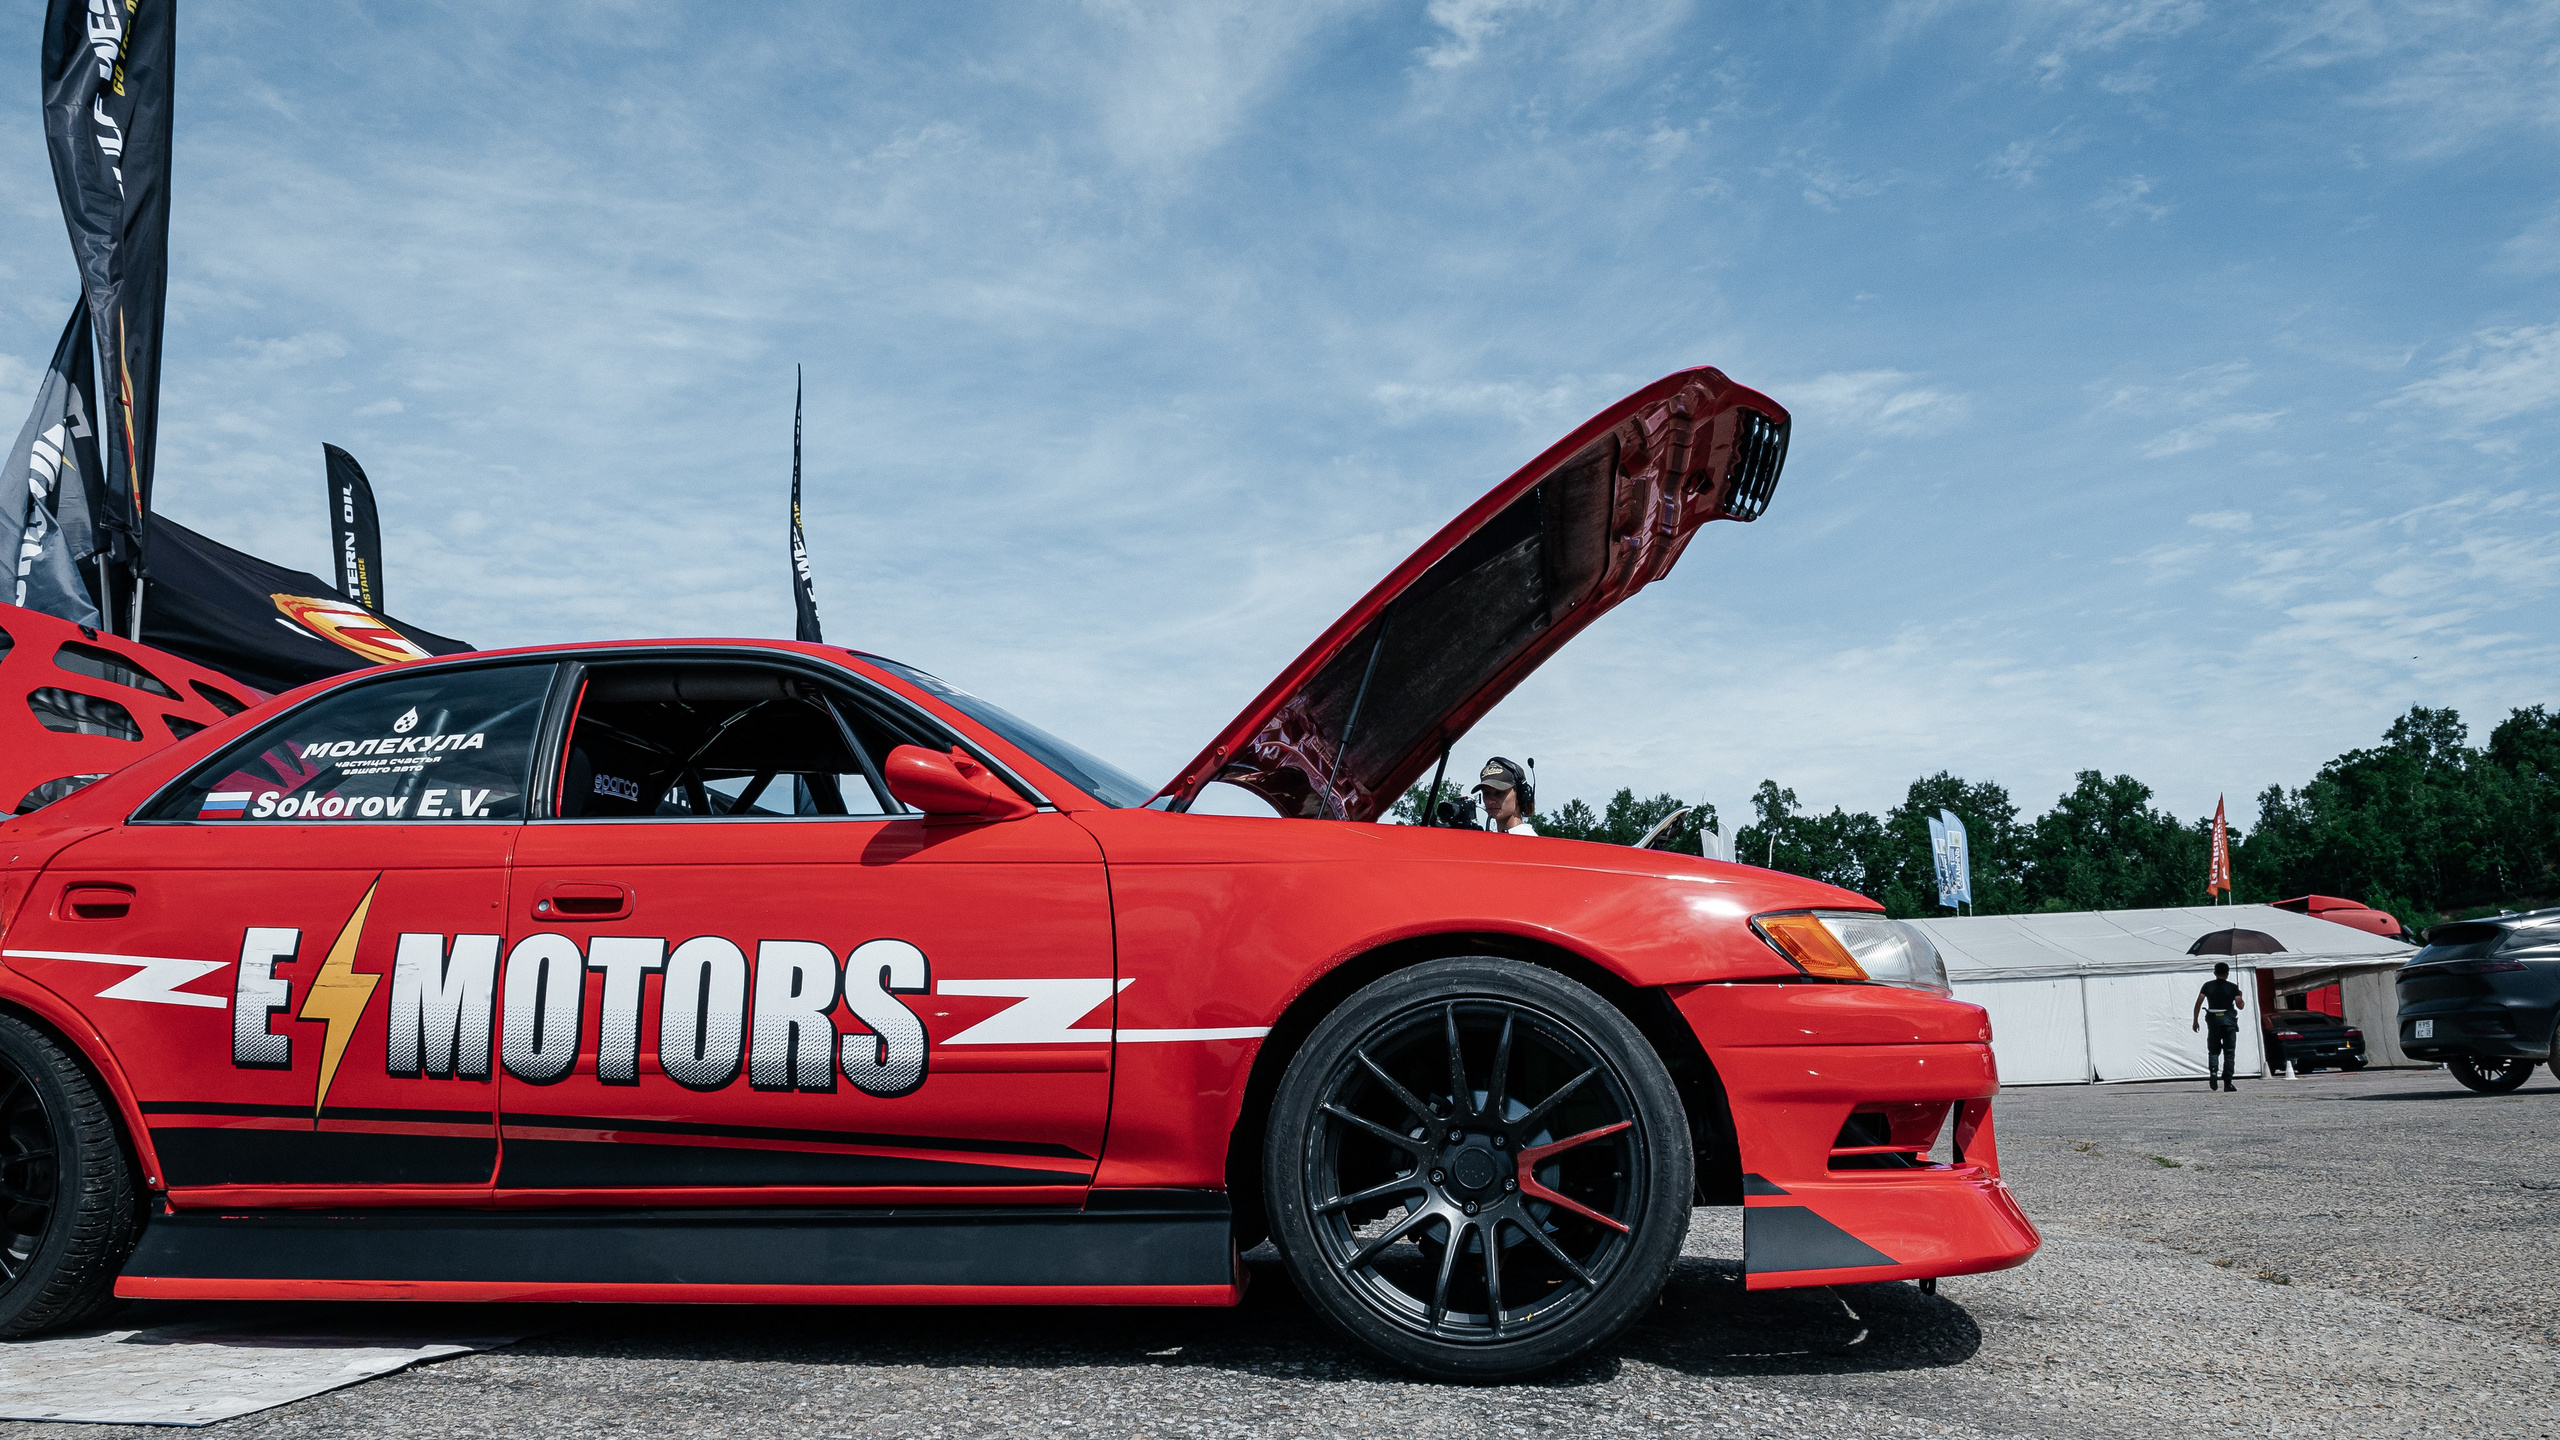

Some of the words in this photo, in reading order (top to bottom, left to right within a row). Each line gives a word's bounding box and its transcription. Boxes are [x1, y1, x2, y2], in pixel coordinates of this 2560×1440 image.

[112, 64, 125, 97] GO
[343, 482, 354, 523] OIL
[345, 531, 361, 602] TERN
[301, 733, 485, 759] МОЛЕКУЛА
[335, 759, 387, 768] частица
[389, 756, 442, 765] счастья
[341, 766, 391, 776] вашего
[391, 764, 424, 773] авто
[594, 773, 639, 798] sparco
[252, 790, 409, 818] Sokorov
[416, 788, 491, 818] E.V.
[232, 926, 301, 1068] E
[386, 932, 930, 1095] MOTORS
